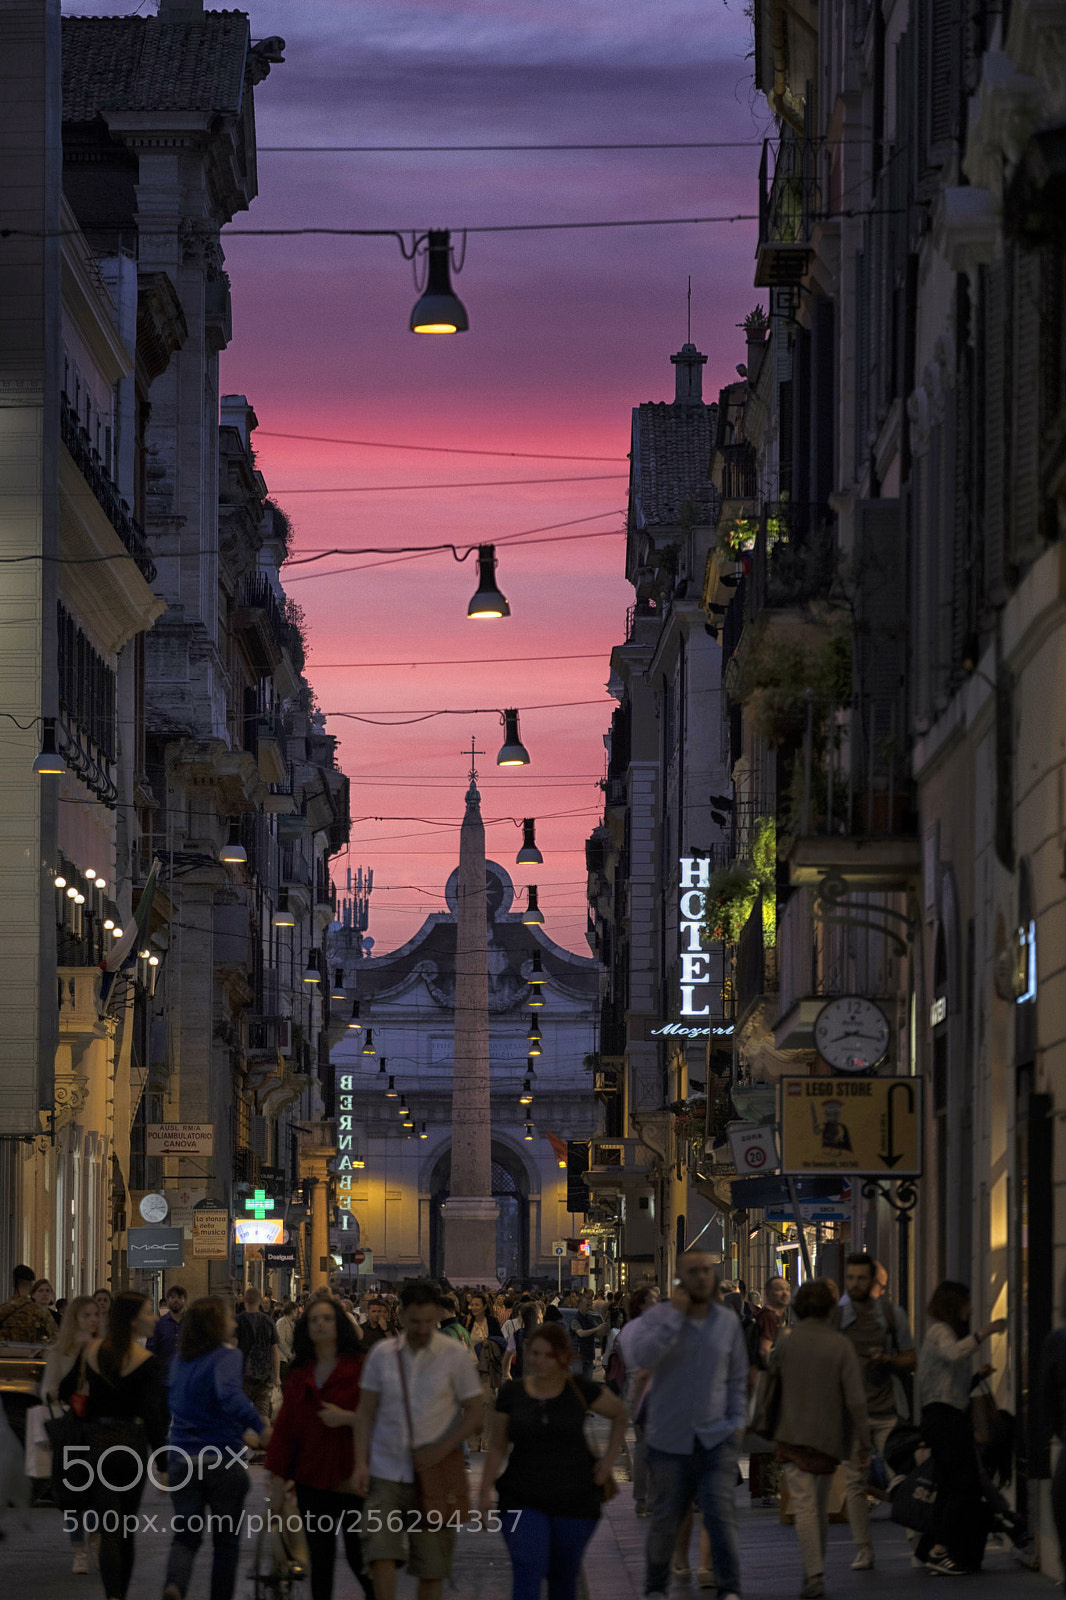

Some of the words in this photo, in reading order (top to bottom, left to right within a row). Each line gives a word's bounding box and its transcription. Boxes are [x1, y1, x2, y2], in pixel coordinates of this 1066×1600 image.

[679, 858, 710, 1015] HOTEL
[848, 1001, 861, 1014] 12
[651, 1023, 735, 1038] Mozart
[806, 1082, 833, 1096] LEGO
[836, 1082, 873, 1096] STORE
[750, 1152, 762, 1163] 20
